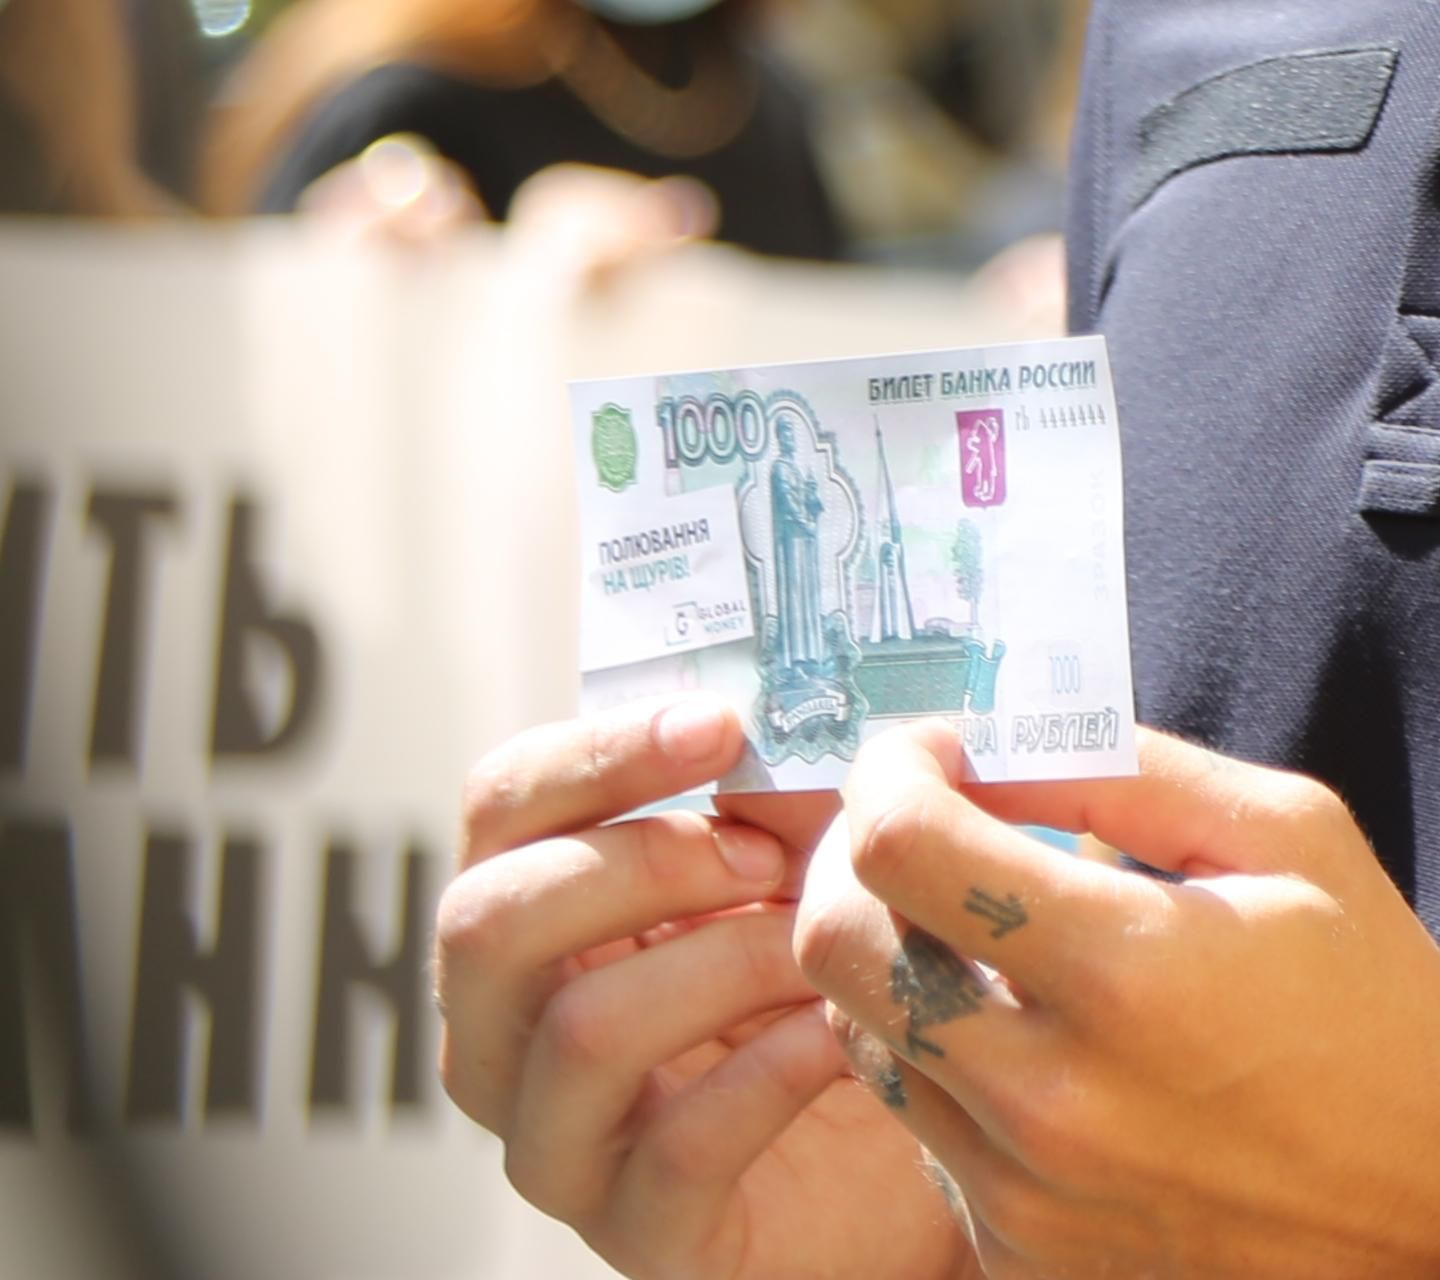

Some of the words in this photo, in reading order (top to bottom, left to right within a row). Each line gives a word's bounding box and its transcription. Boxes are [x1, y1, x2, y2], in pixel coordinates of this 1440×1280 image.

[868, 372, 935, 402] БИЛЕТ
[940, 366, 1012, 397] БАНКА
[1018, 360, 1096, 390] РОССИИ
[655, 390, 769, 469] 1000
[598, 518, 710, 566] ПОЛЮВАННЯ
[602, 569, 629, 595] НА
[1011, 706, 1120, 753] РУБЛЕЙ
